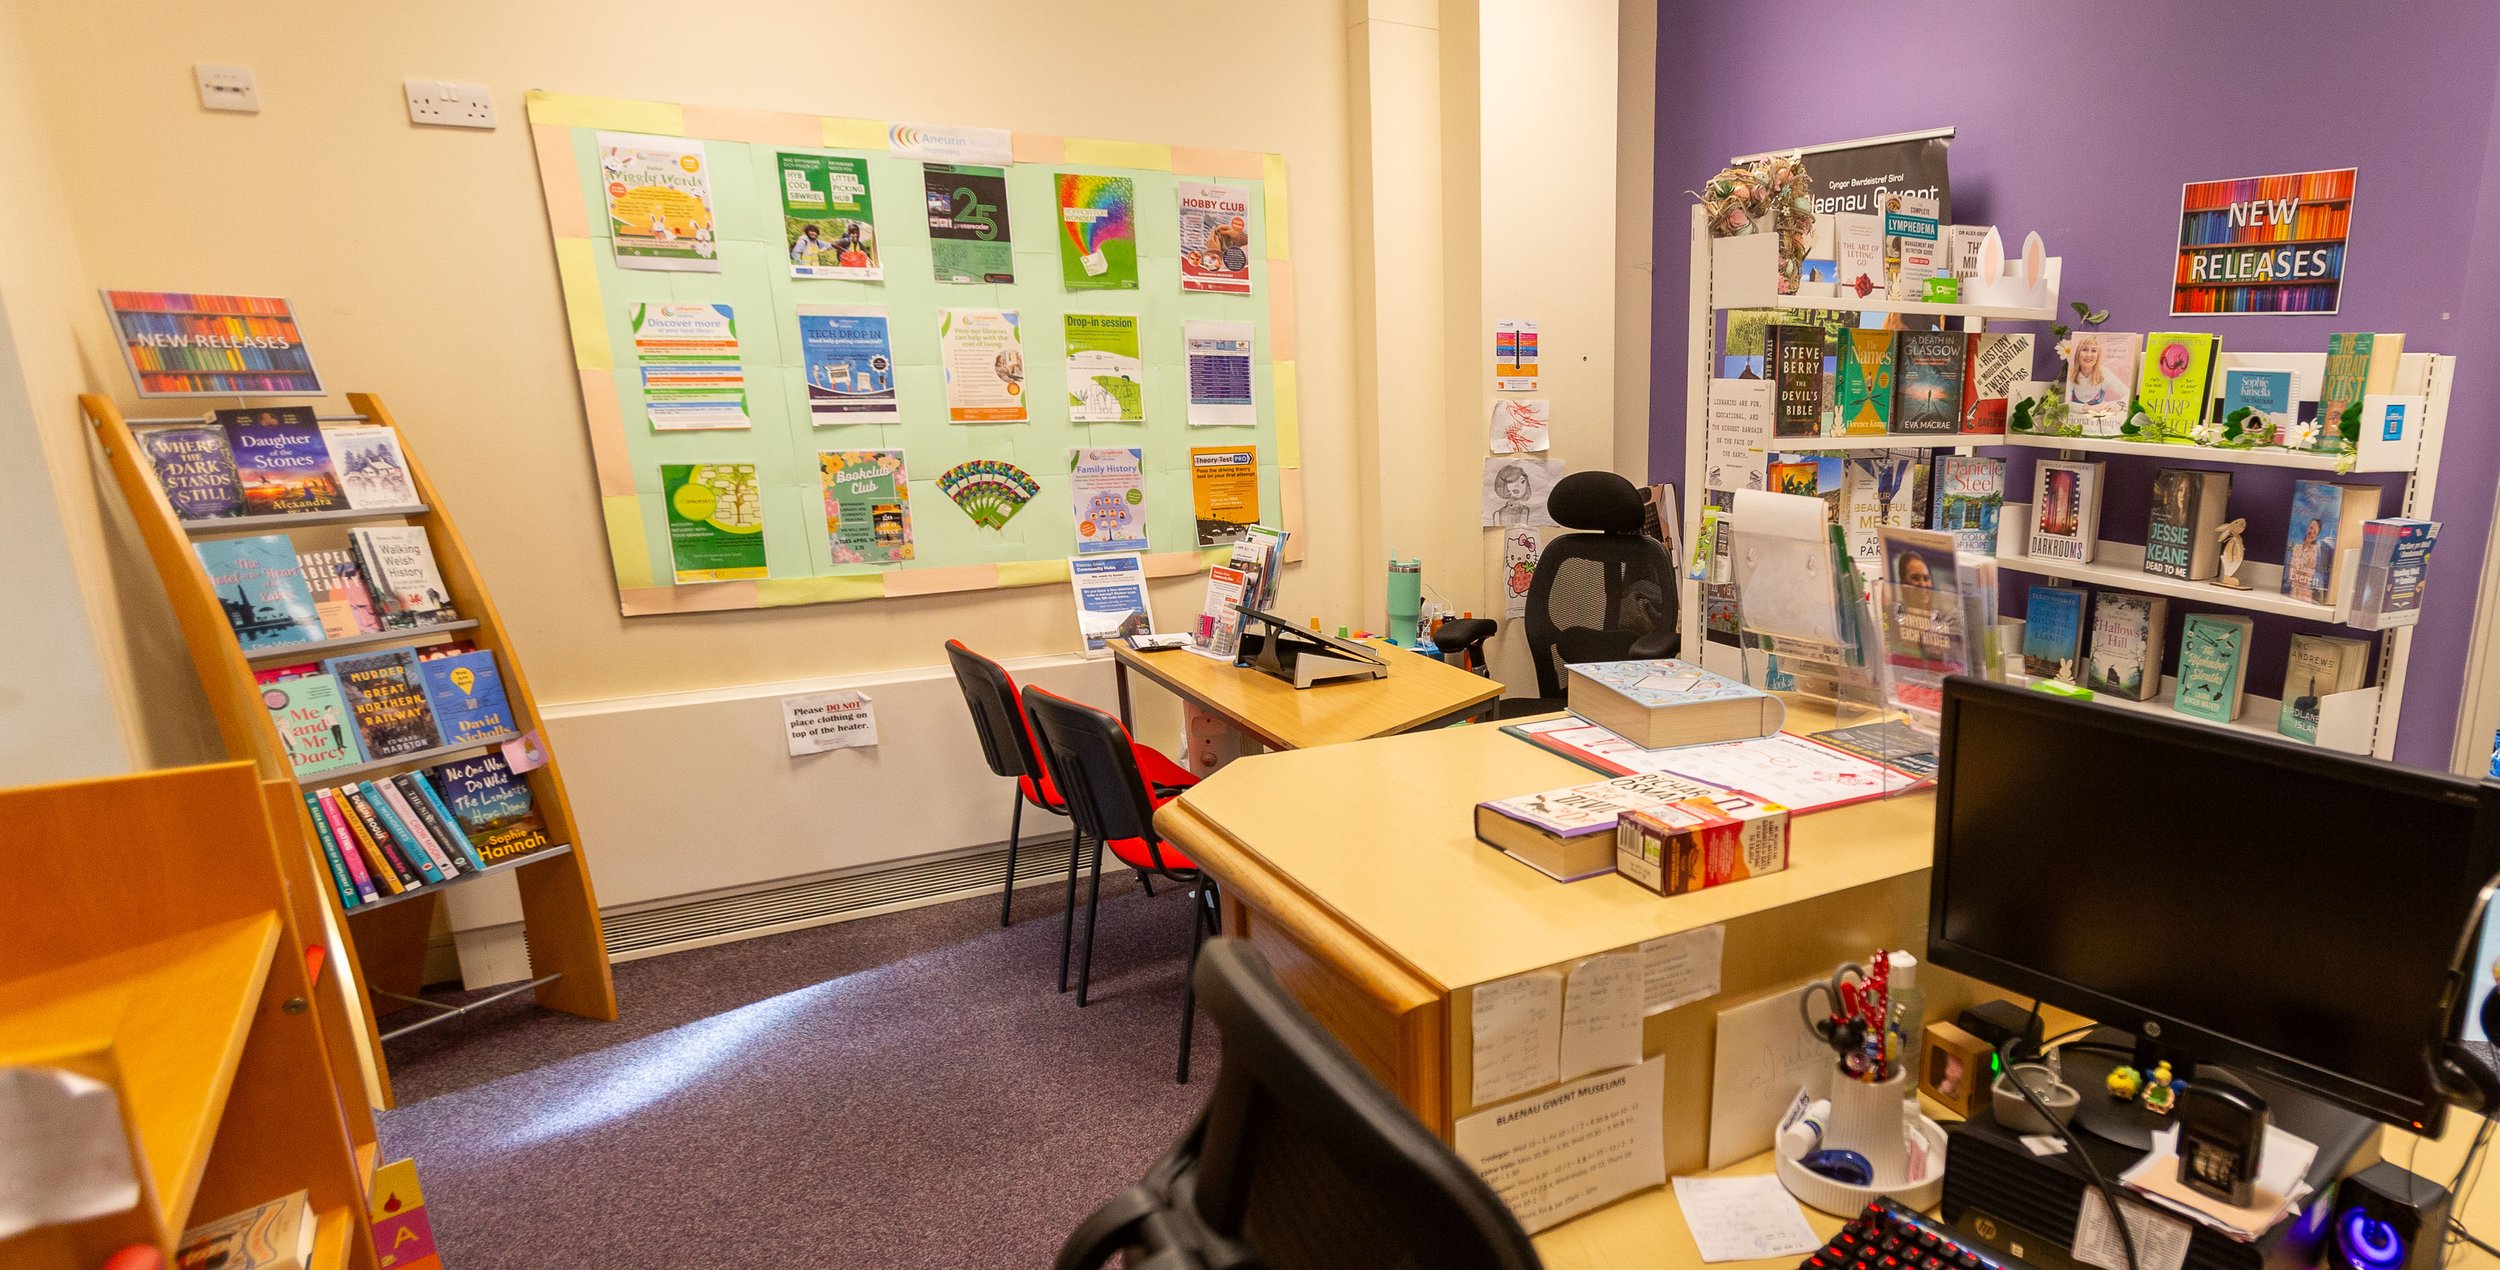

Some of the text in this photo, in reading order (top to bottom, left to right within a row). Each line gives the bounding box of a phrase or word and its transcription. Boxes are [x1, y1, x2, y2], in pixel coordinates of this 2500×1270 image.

[922, 133, 966, 145] Aneurin
[1851, 175, 1888, 187] Bwrdeistref
[1183, 198, 1216, 209] HOBBY
[1805, 193, 1868, 214] laenau
[2228, 197, 2299, 228] NEW
[1888, 219, 1935, 235] LYMPHEDEMA
[2192, 249, 2327, 280] RELEASES
[648, 319, 691, 327] Discover
[1067, 316, 1132, 328] Drop-in session
[138, 333, 290, 351] NEW RELEASES
[1784, 347, 1820, 359] STEVE
[1850, 346, 1892, 365] Names
[1904, 346, 1960, 356] GLASGOW
[1980, 335, 2011, 366] HISTORY
[1981, 336, 2029, 381] MODERN BRITAIN
[1783, 362, 1820, 374] BERRY
[1984, 366, 2013, 393] TWENTY
[2241, 377, 2269, 389] Sophie
[1782, 391, 1818, 401] DEVIL'S
[2241, 386, 2271, 397] Kinsella
[155, 440, 219, 454] WHERE
[240, 434, 310, 449] Daughter
[165, 461, 220, 475] DARK
[254, 455, 314, 469] Stones
[1107, 465, 1138, 474] History
[1946, 460, 2004, 477] Danielle
[167, 474, 231, 488] STANDS
[836, 465, 892, 483] Bookclub
[851, 481, 879, 494] Club
[1954, 475, 1995, 492] Steel
[178, 488, 231, 504] STILL
[273, 499, 332, 509] Alexandra
[1854, 503, 1908, 512] BEAUTIFUL
[1860, 516, 1900, 528] MESS
[2152, 523, 2189, 544] JESSIE
[379, 544, 420, 555] Walking
[2032, 537, 2082, 559] DARKROOMS
[2147, 543, 2188, 566] KEANE
[384, 556, 416, 566] Welsh
[389, 567, 424, 579] History
[2290, 572, 2319, 585] Everest
[2099, 620, 2141, 638] Hallows
[1922, 632, 1951, 648] HYDER
[2107, 634, 2128, 649] Hill
[2187, 654, 2229, 672] Alphabet
[2291, 650, 2335, 668] ANDREWS
[350, 666, 405, 682] MURDER
[2190, 668, 2224, 686] Sleuths
[363, 683, 405, 699] GREAT
[356, 694, 422, 713] NORTHERN
[794, 707, 824, 716] Please
[290, 708, 319, 722] Me
[365, 707, 421, 726] RAILWAY
[458, 713, 500, 731] David
[817, 713, 854, 723] clothing
[293, 719, 328, 737] and
[454, 725, 511, 743] Nicholls
[837, 723, 869, 732] heater.
[302, 735, 328, 749] Mr
[382, 739, 428, 754] MARSTON
[388, 735, 418, 745] EDWARD
[291, 748, 346, 767] Darcy
[483, 773, 508, 788] What
[1634, 773, 1711, 797] RICHAR
[455, 784, 528, 810] The Lamberts
[408, 790, 437, 825] THE NINE
[472, 801, 527, 825] Have Done
[352, 793, 386, 841] DUBLIN ROGUE
[337, 826, 353, 852] DATING
[355, 824, 374, 849] EXPRESS
[410, 818, 443, 861] CROW MOON
[489, 829, 527, 845] Sophie
[476, 832, 546, 862] Hannah
[335, 863, 349, 888] DIPLOMAT
[2146, 1021, 2161, 1037] hp
[1496, 1077, 1626, 1126] BLAENAU GWENT MUSEUMS
[1978, 1219, 1996, 1239] hp
